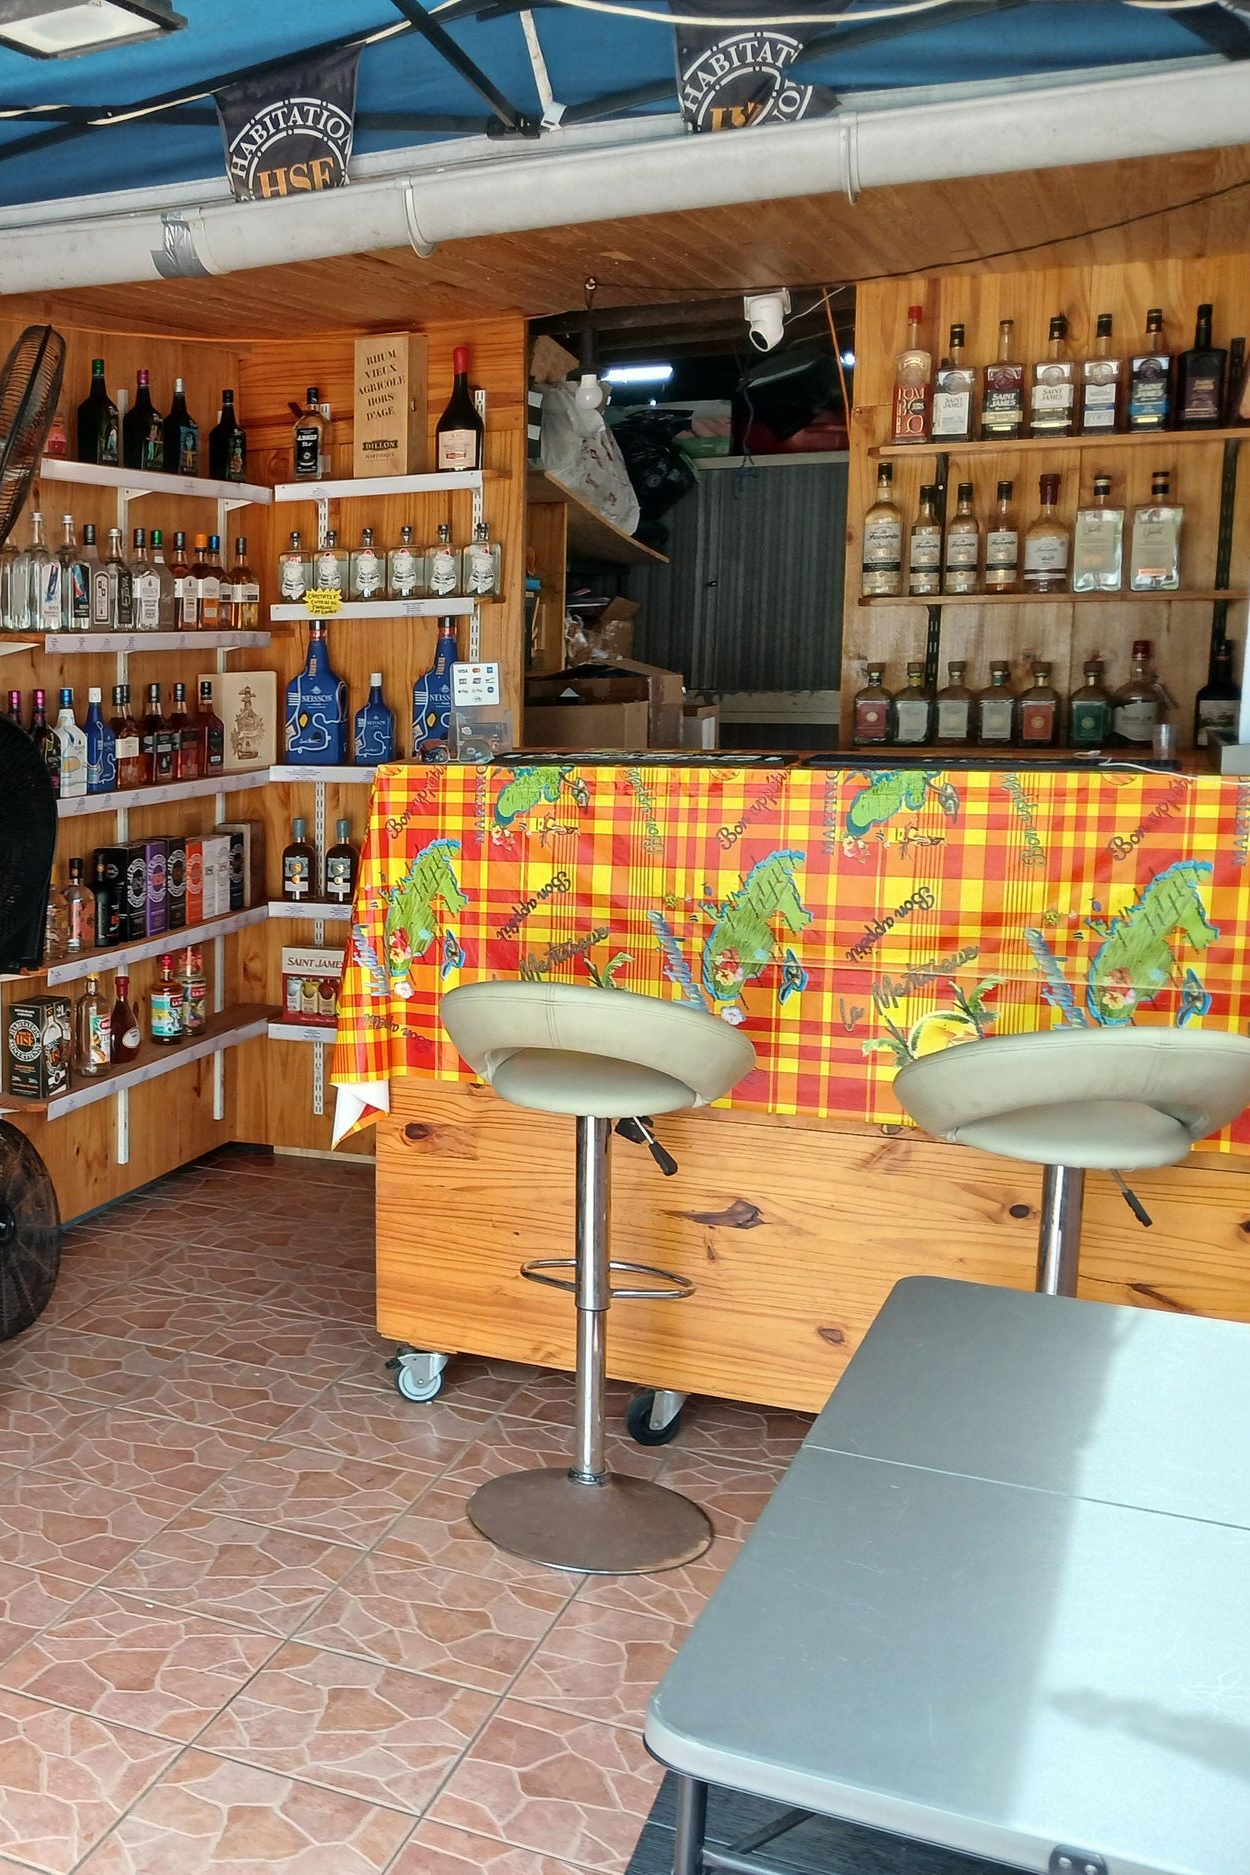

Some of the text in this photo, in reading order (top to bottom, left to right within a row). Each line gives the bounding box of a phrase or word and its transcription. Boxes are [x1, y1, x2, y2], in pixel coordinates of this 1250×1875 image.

[366, 350, 397, 366] RHUM
[365, 364, 398, 379] VIEUX
[357, 375, 406, 396] AGRICOLE
[1043, 387, 1063, 395] SAINT
[367, 393, 395, 407] HORS
[944, 396, 964, 404] SAINT
[988, 398, 1017, 408] JAMES
[992, 392, 1017, 401] SAINT
[364, 441, 397, 451] DILLON
[302, 694, 333, 702] NEISSON
[429, 693, 450, 702] NEISS
[385, 807, 414, 840] Bon
[716, 817, 750, 850] Bon
[1109, 827, 1147, 861] Bon
[537, 871, 572, 900] Bon
[894, 886, 935, 919] Bon
[287, 957, 342, 969] SAINT JAME
